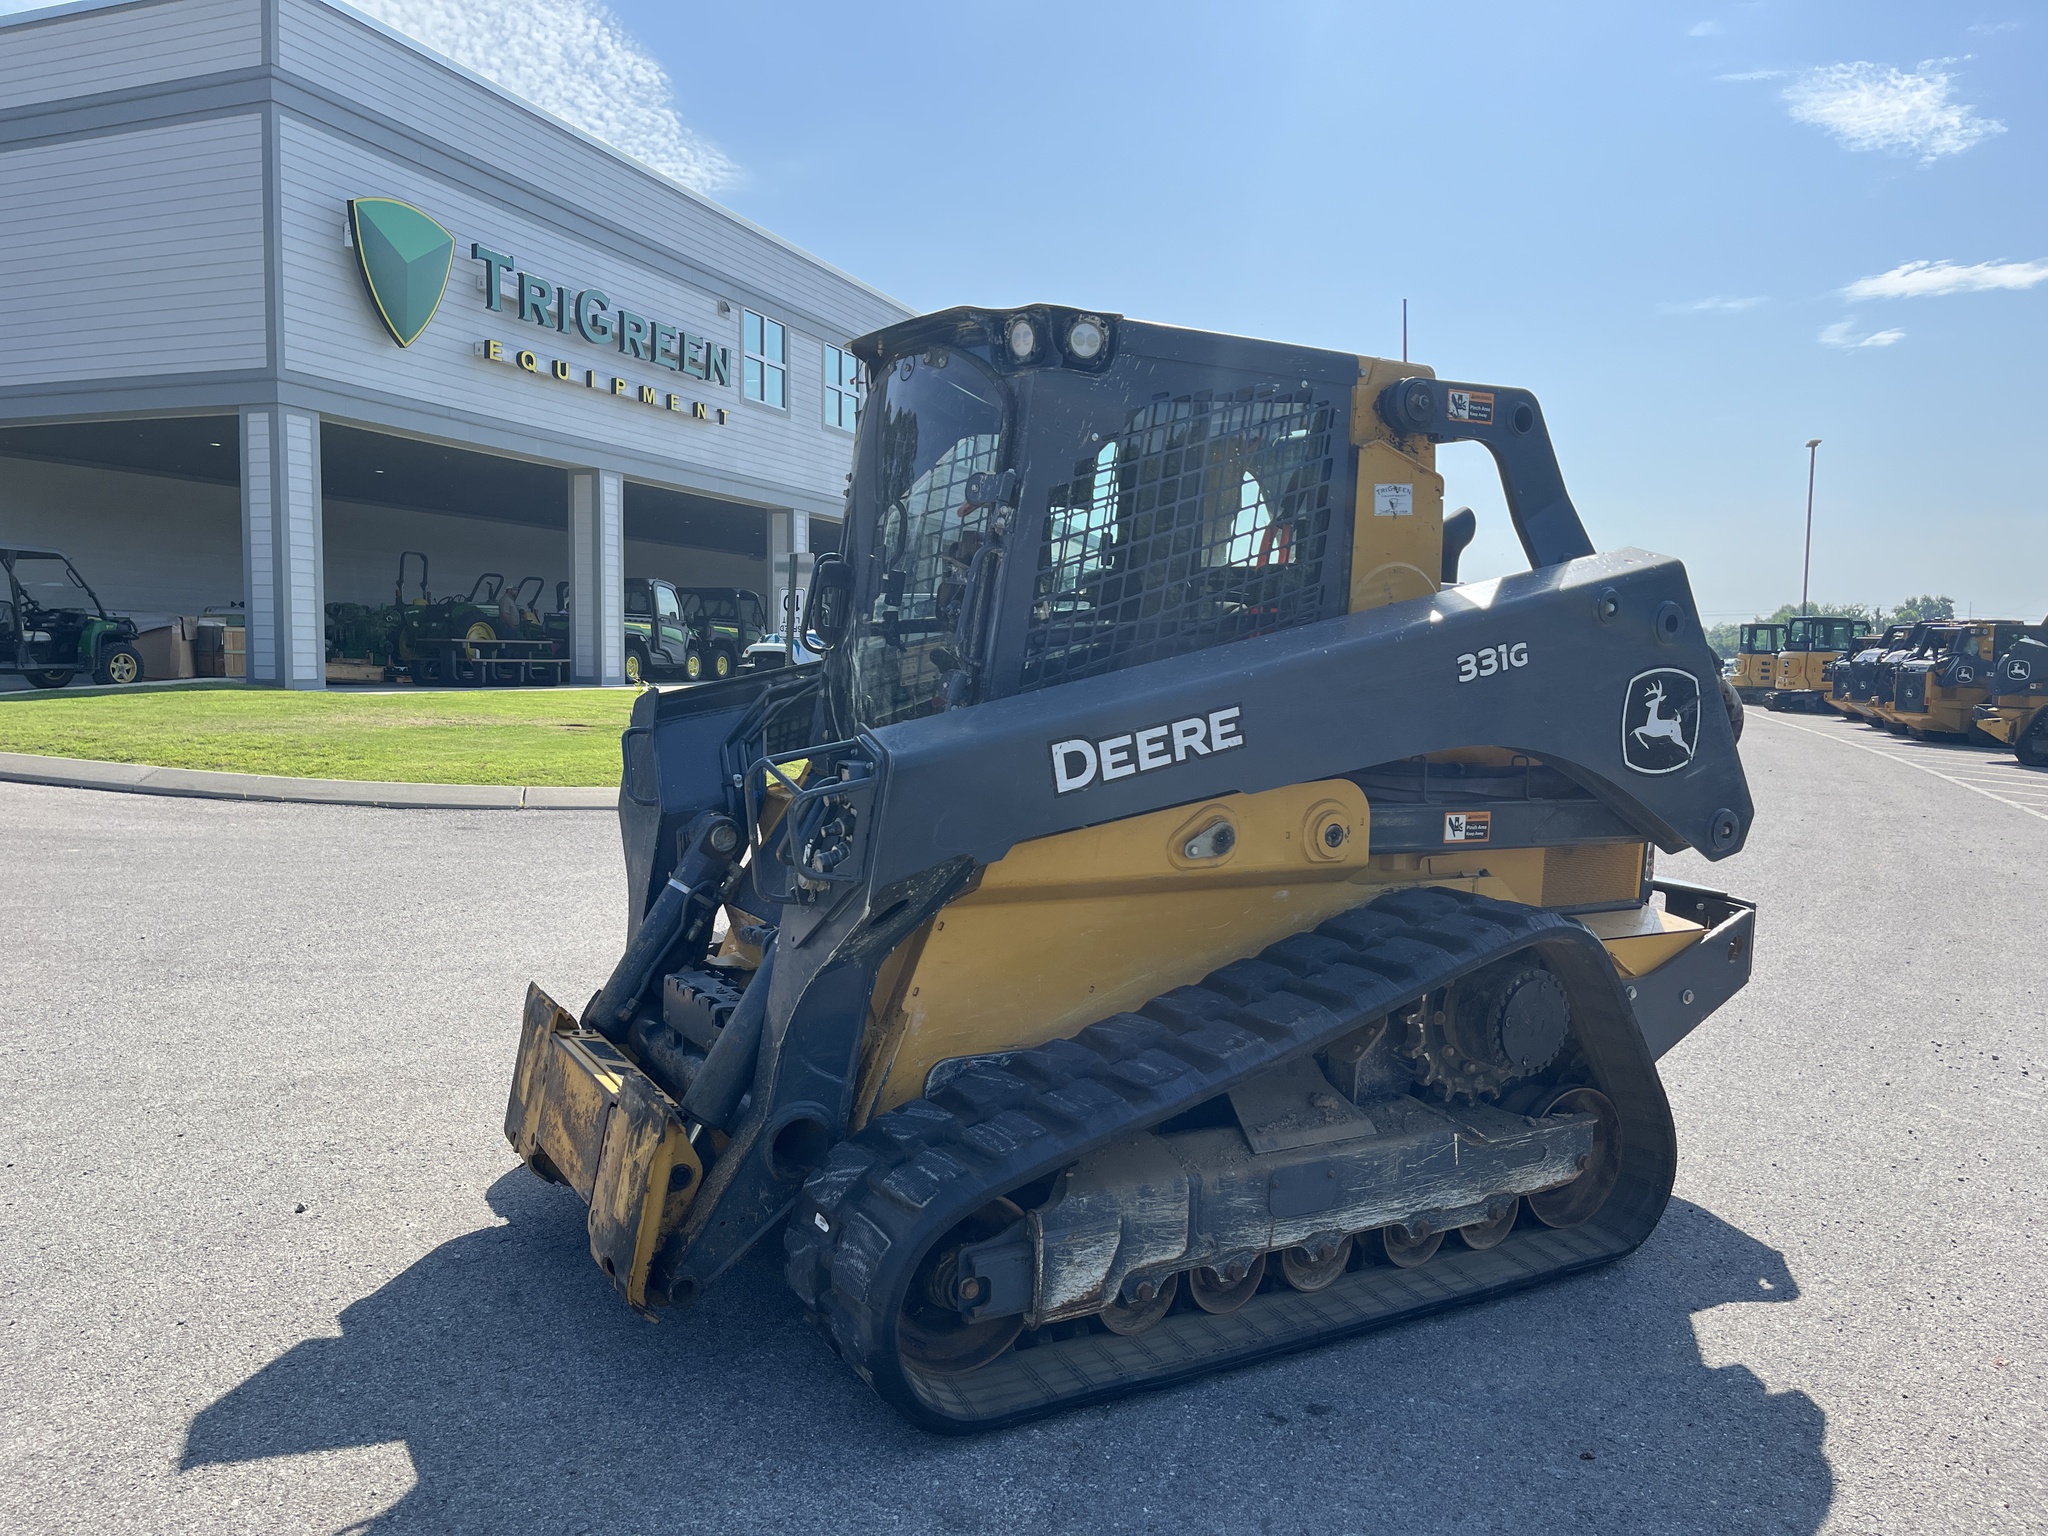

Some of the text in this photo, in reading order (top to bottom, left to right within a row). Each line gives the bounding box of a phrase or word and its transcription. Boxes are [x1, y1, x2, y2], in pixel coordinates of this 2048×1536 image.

[471, 243, 732, 387] TRIGREEN
[484, 339, 730, 426] EQUIPMENT
[1456, 642, 1529, 683] 331G
[1051, 706, 1244, 794] DEERE
